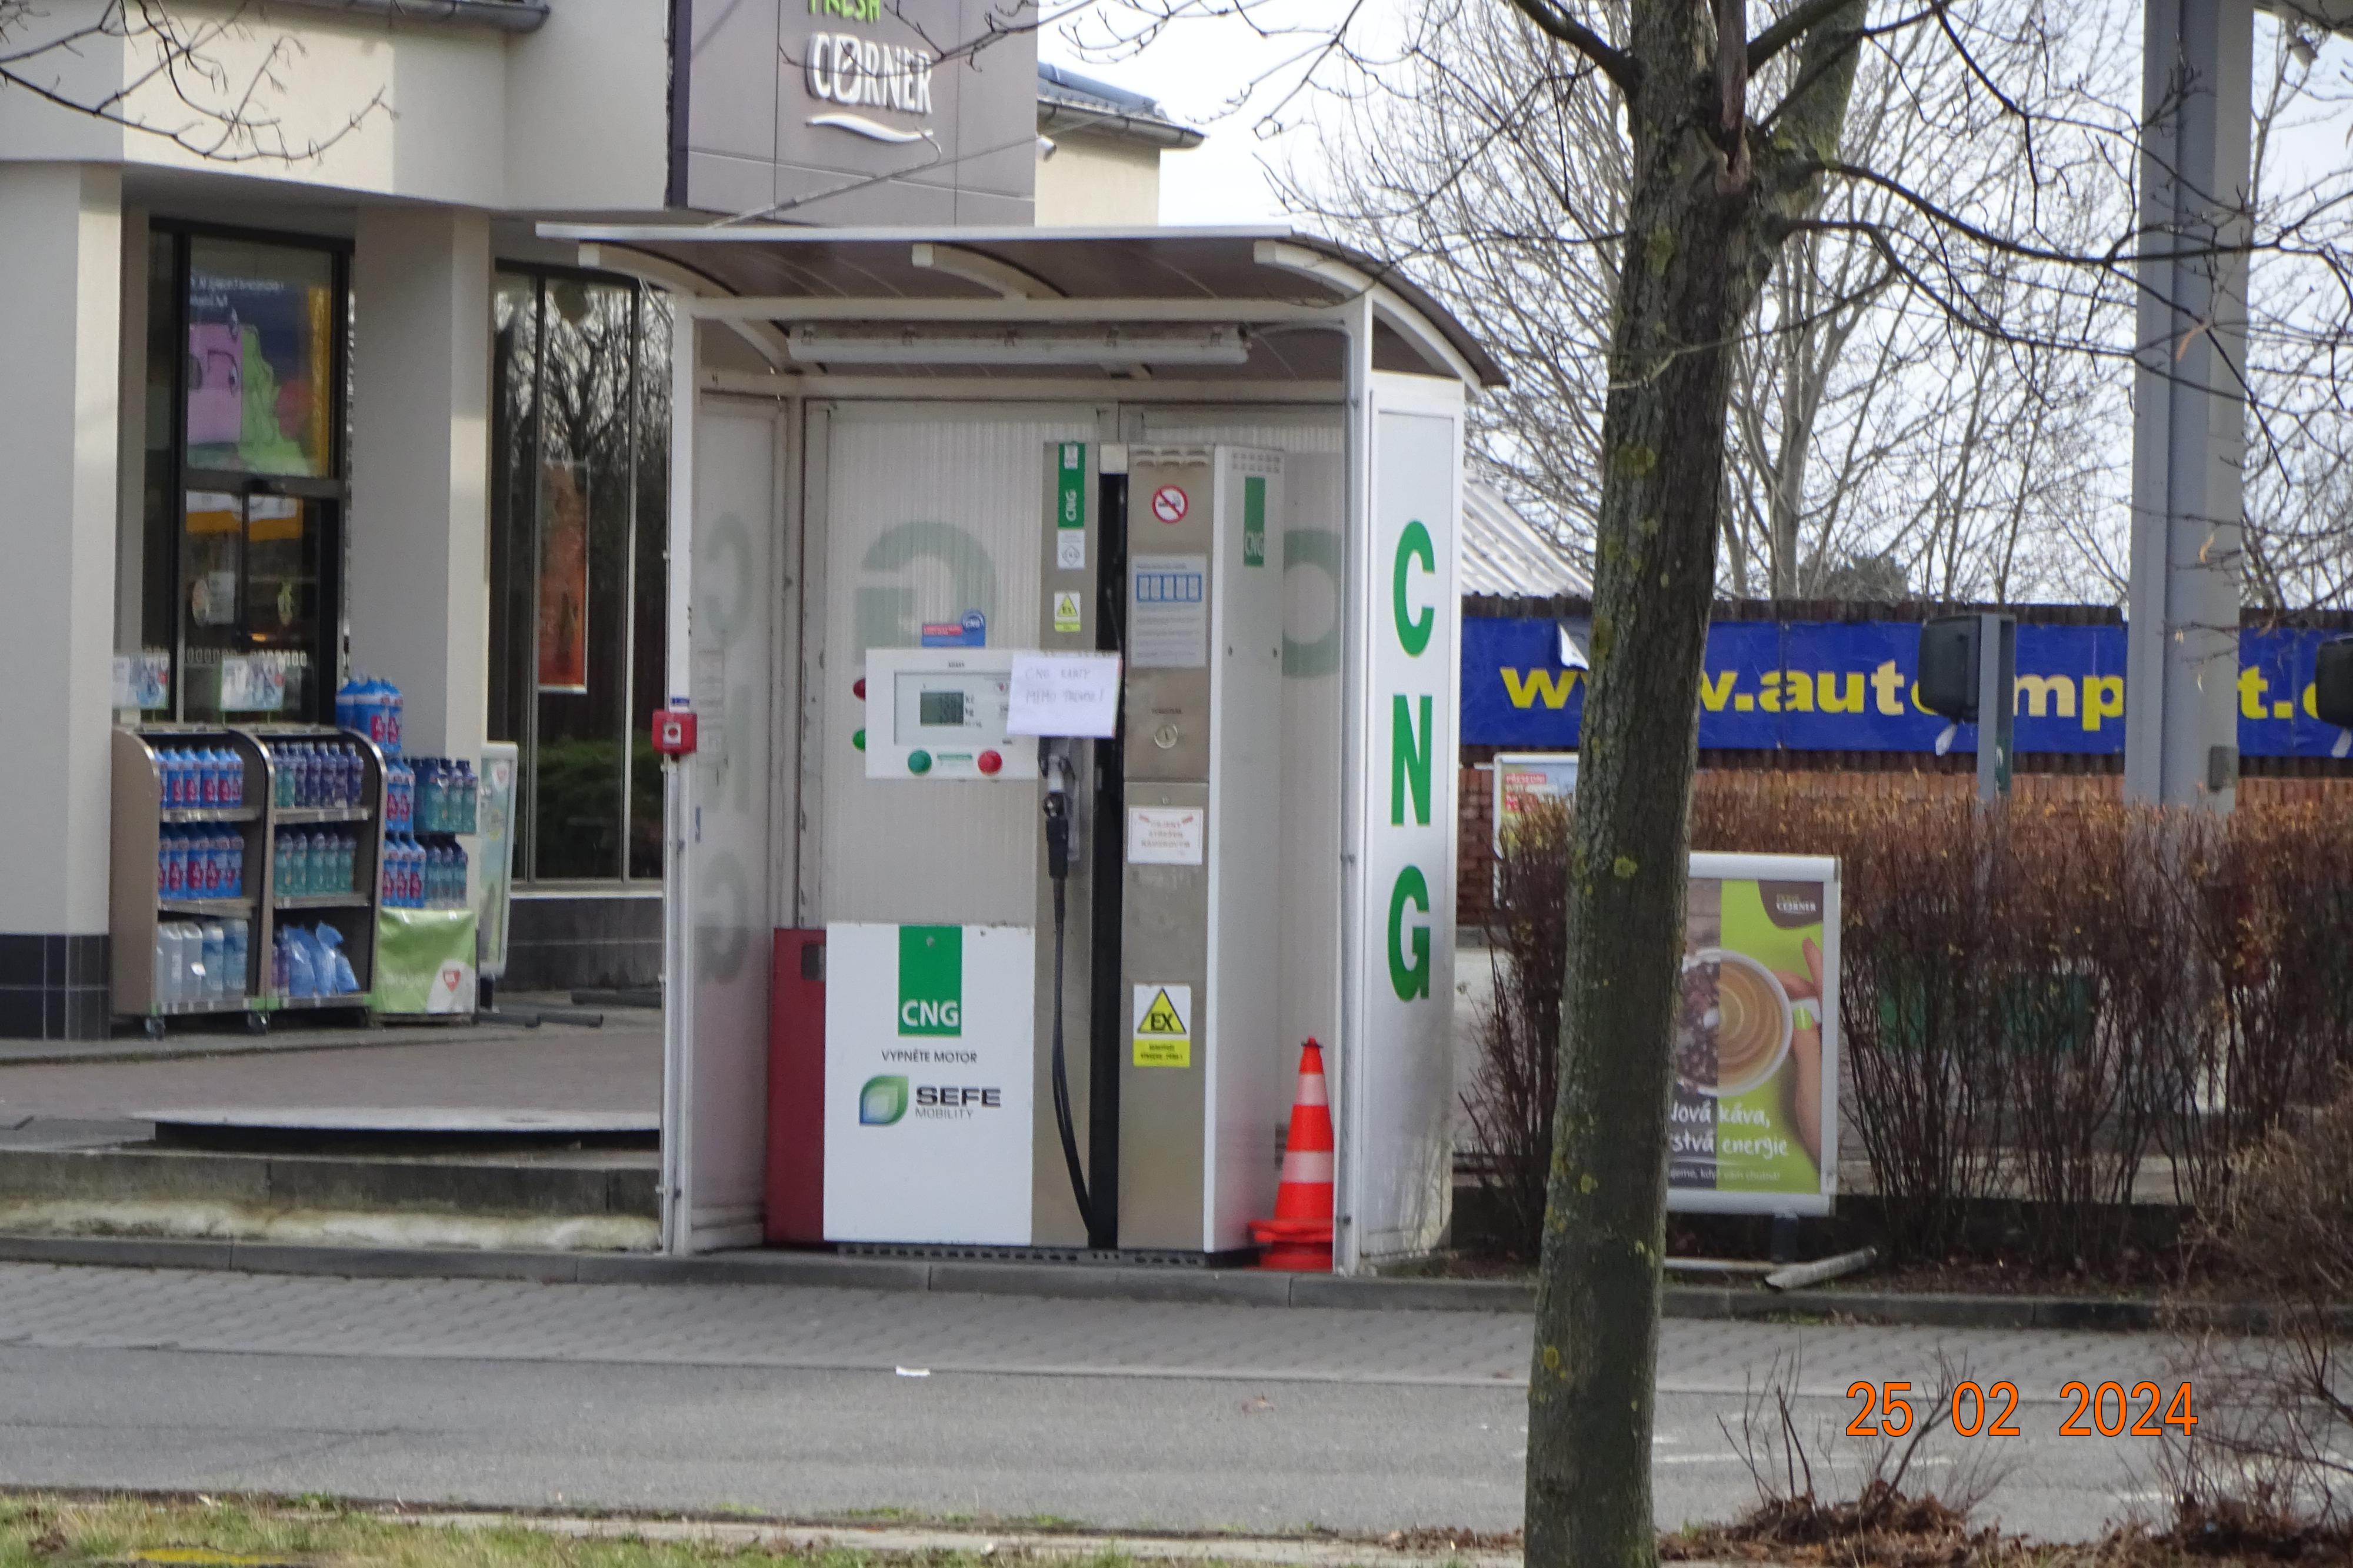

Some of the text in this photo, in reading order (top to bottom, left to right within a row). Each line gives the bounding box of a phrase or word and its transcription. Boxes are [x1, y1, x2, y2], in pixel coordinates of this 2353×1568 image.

[808, 32, 932, 114] CORNER
[1387, 519, 1435, 1002] CNG
[901, 999, 959, 1027] CNG
[1151, 1012, 1174, 1032] EX
[881, 1048, 978, 1064] VYPNĚTE MOTOR
[916, 1086, 1001, 1108] SEFE
[915, 1107, 974, 1120] MOBILITY
[1718, 1102, 1770, 1129] káva,
[1722, 1135, 1788, 1160] energie
